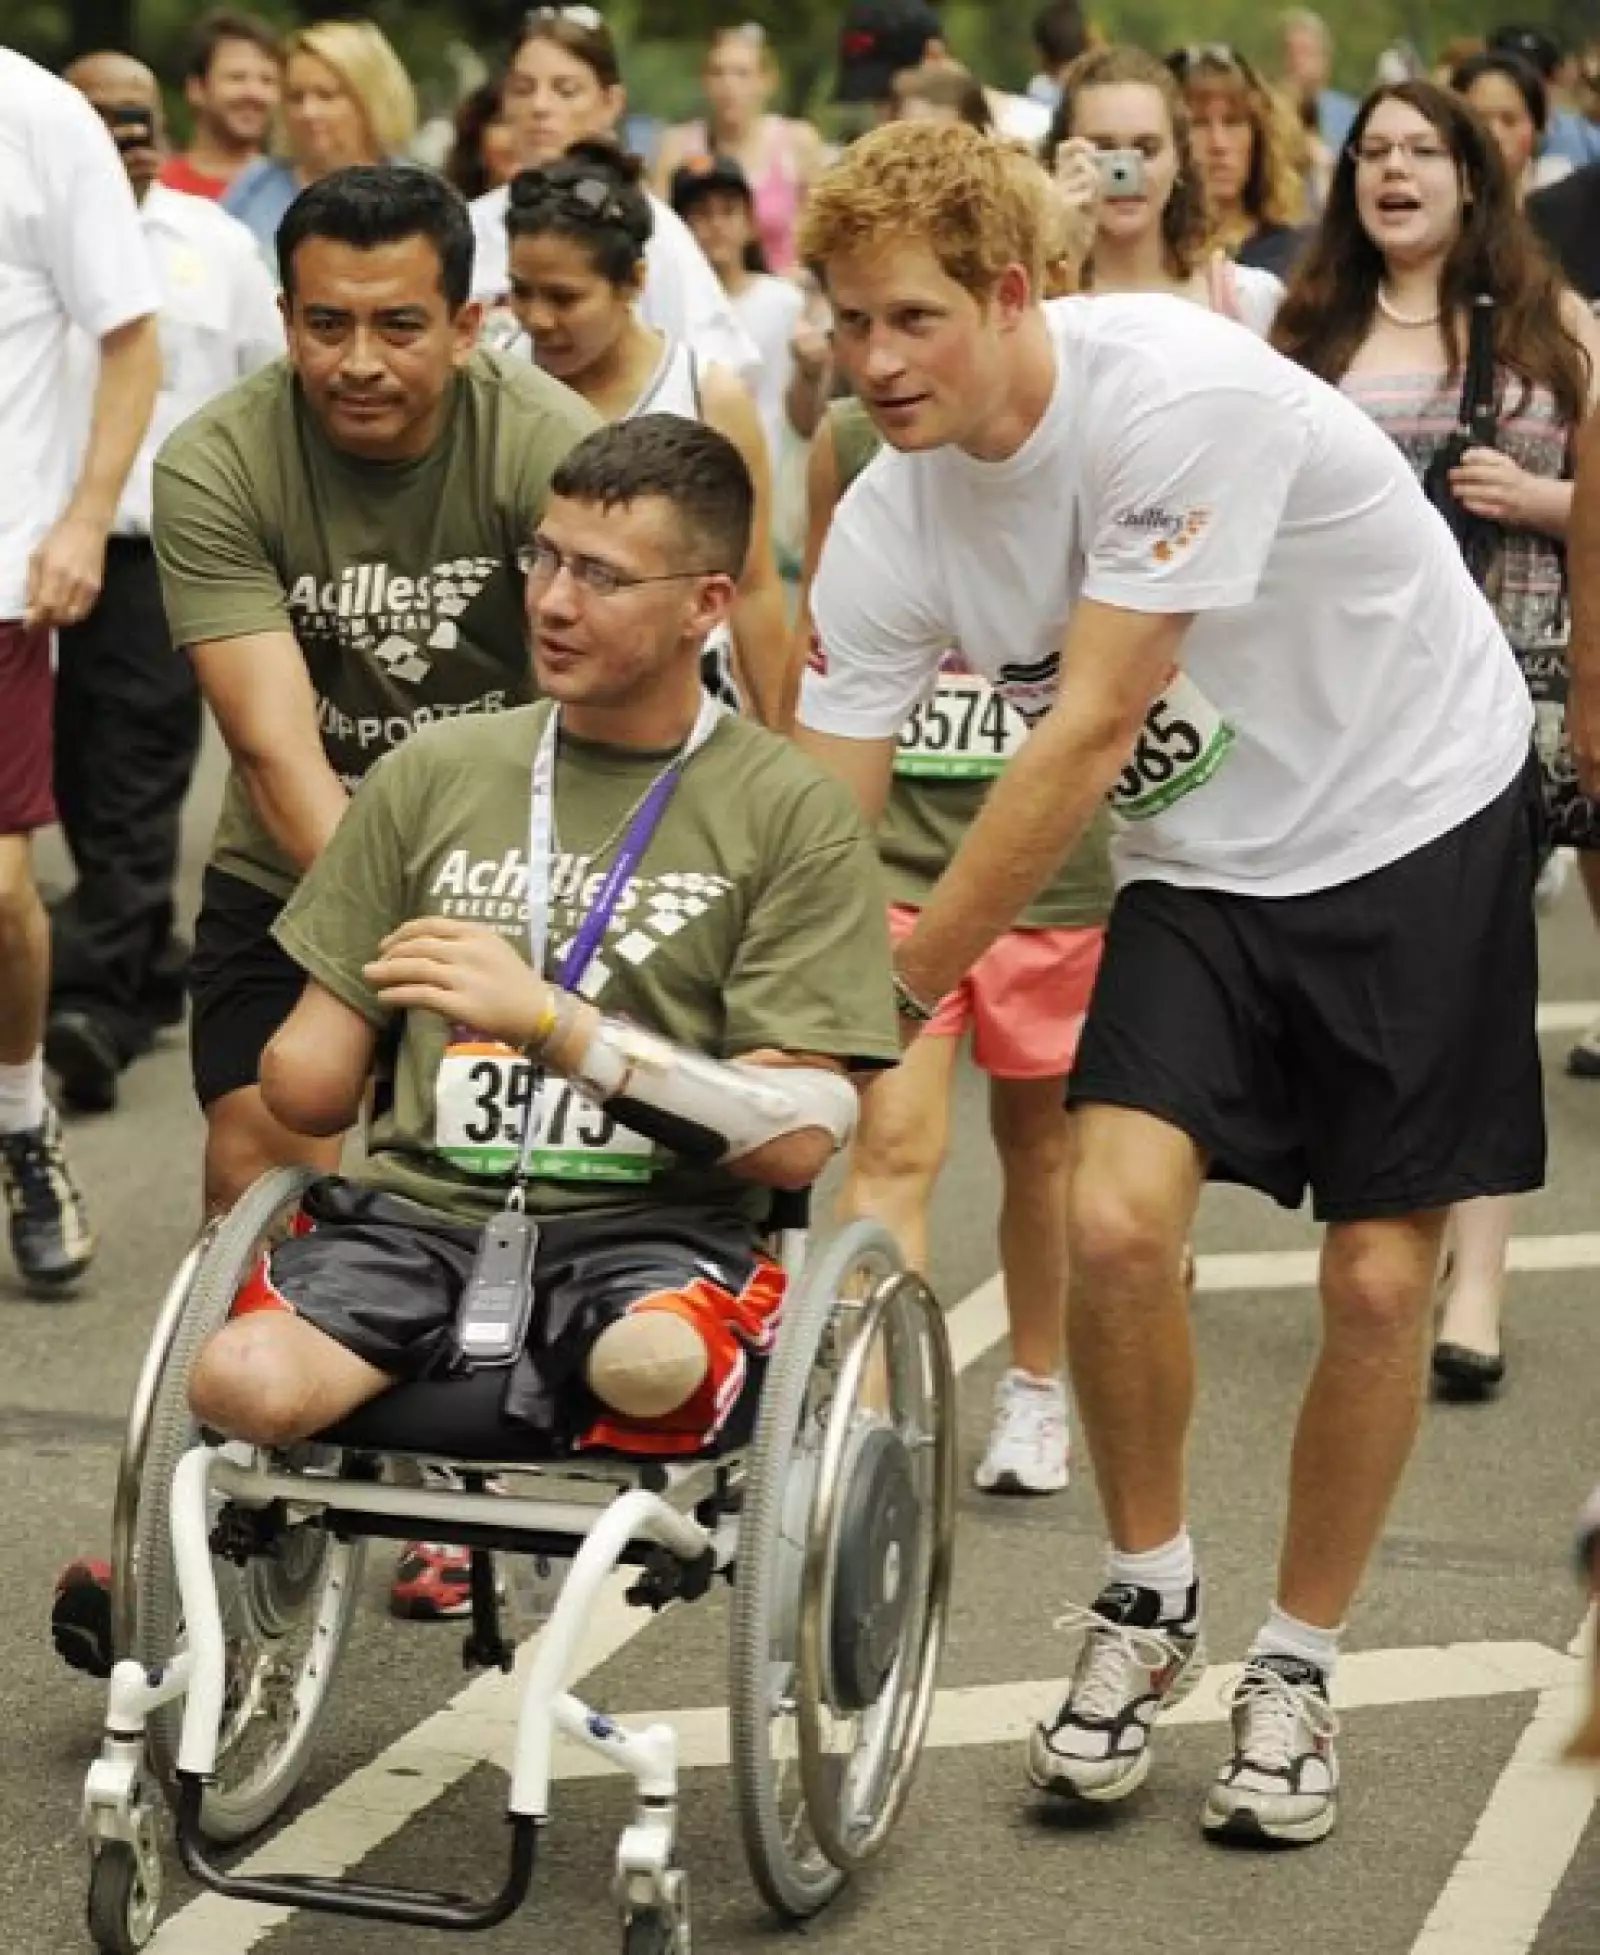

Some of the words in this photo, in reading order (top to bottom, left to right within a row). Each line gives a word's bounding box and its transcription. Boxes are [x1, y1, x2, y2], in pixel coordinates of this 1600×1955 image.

[898, 690, 1011, 753] 3574
[430, 849, 641, 913] Achlles
[442, 898, 556, 924] FREEDO
